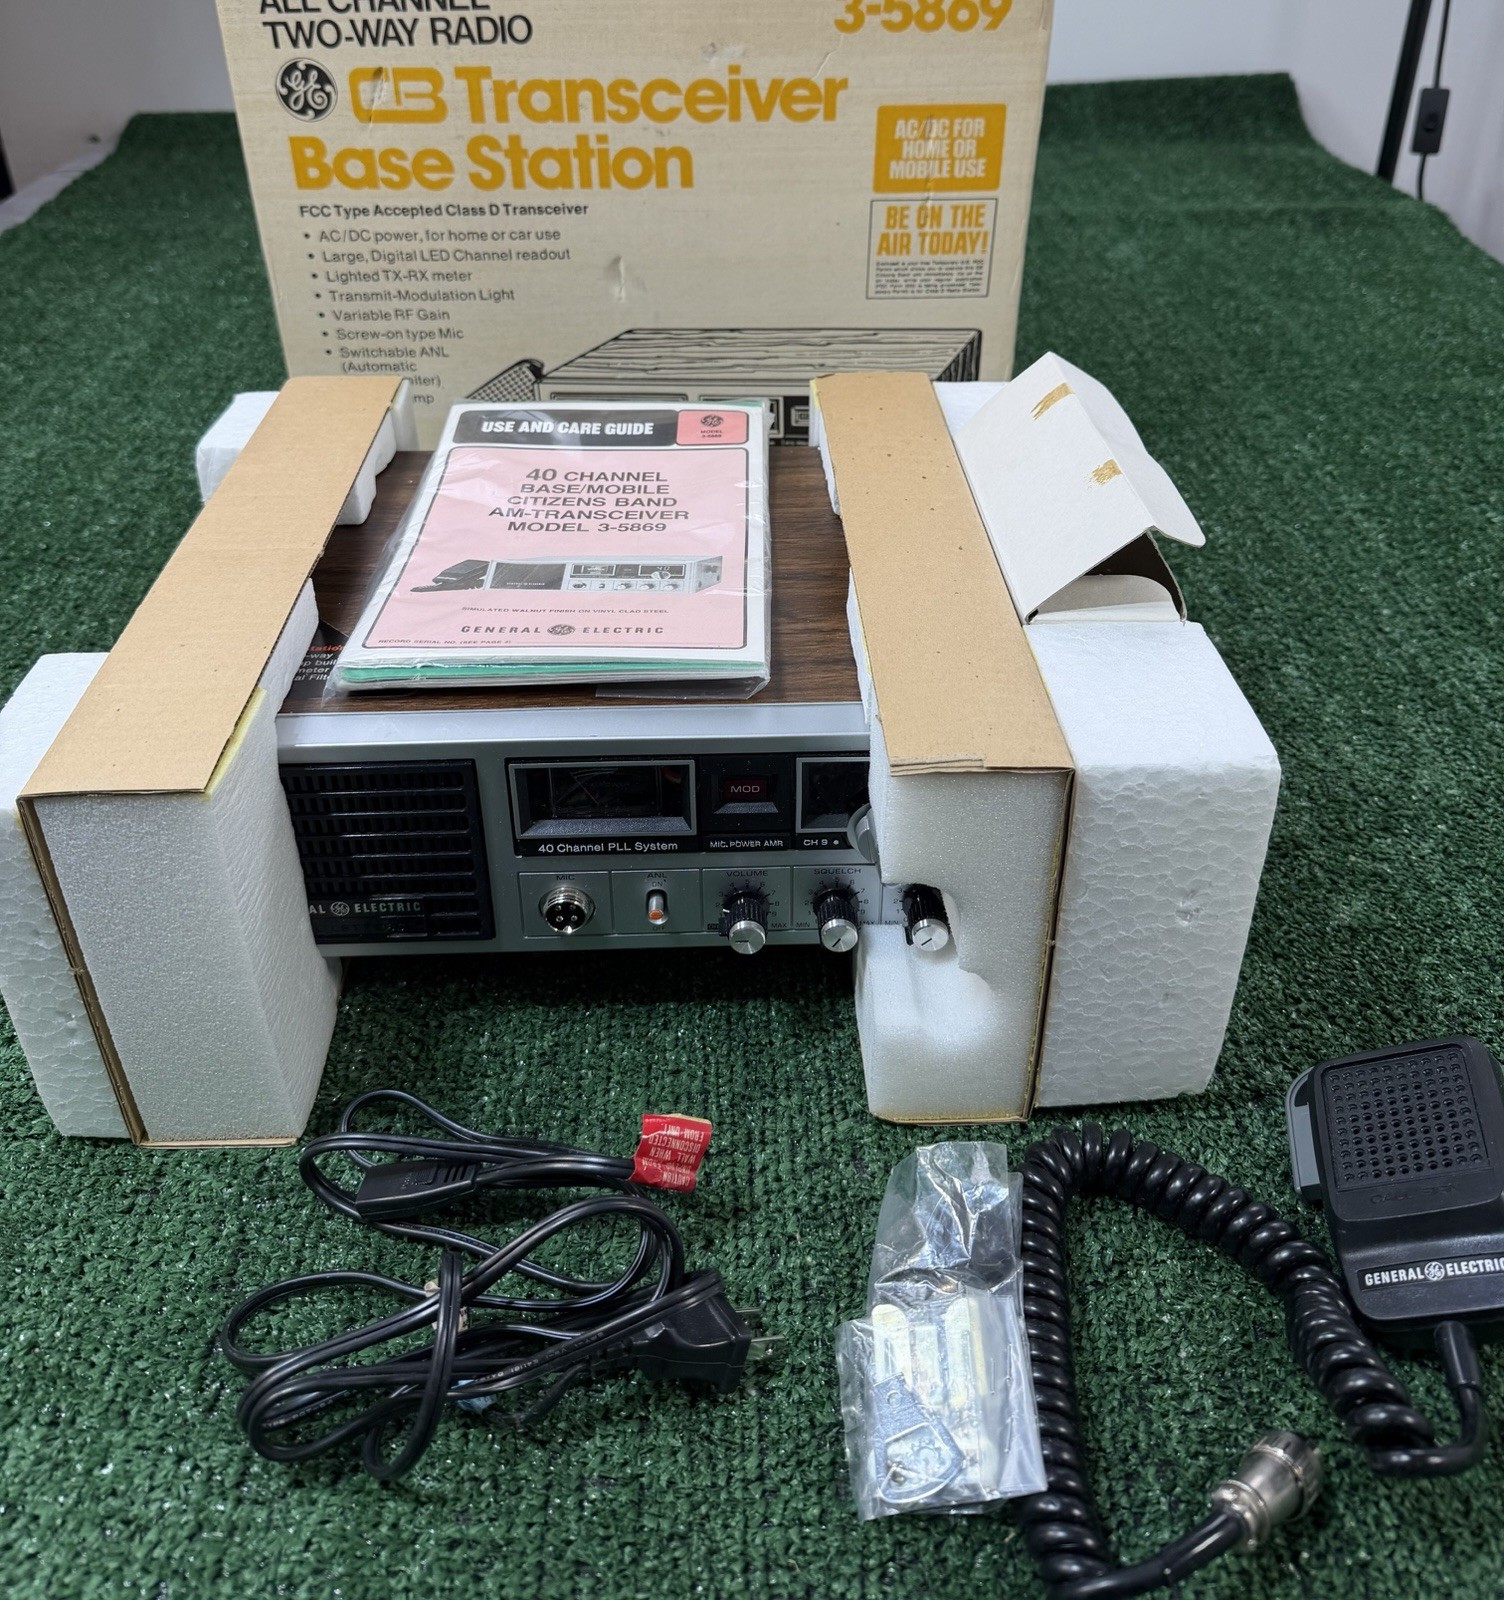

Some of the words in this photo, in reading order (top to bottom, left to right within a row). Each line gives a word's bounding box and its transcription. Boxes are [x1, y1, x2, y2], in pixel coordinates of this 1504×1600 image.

[833, 0, 1013, 34] 3-5869
[262, 18, 419, 49] TWO-WAY
[430, 15, 533, 46] RADIO
[348, 66, 448, 124] CB
[454, 64, 849, 124] Transceiver
[894, 117, 950, 139] AC/DC
[952, 117, 985, 138] FOR
[902, 139, 951, 160] HOME
[952, 139, 977, 159] OR
[288, 135, 455, 191] Base
[466, 134, 694, 190] Station
[889, 159, 951, 179] MOBILE
[953, 158, 986, 178] USE
[299, 205, 332, 218] FCC
[333, 205, 371, 220] Type
[374, 204, 443, 219] Accepted
[446, 204, 487, 217] Class
[490, 205, 500, 217] D
[503, 203, 589, 217] Transceiver
[885, 205, 909, 229] BE
[916, 204, 943, 229] ON
[951, 203, 986, 229] THE
[319, 230, 372, 243] AC/DC
[374, 231, 424, 245] power,
[425, 229, 447, 242] for
[449, 230, 489, 242] home
[492, 231, 507, 241] or
[509, 231, 533, 241] car
[536, 231, 561, 241] use
[876, 231, 911, 256] AIR
[918, 230, 989, 255] TODAY!
[323, 251, 369, 265] Large,
[371, 250, 419, 263] Digital
[421, 250, 450, 262] LED
[453, 249, 513, 261] Channel
[516, 248, 571, 261] readout
[326, 270, 380, 284] Lighted
[382, 270, 430, 282] TX-RX
[432, 271, 473, 282] meter
[329, 289, 477, 302] Transmit-Modulation
[480, 288, 515, 303] Light
[332, 309, 392, 322] Variable
[394, 310, 415, 321] RF
[417, 309, 450, 321] Gain
[336, 328, 404, 340] Screw-on
[406, 328, 437, 342] type
[439, 328, 464, 339] Mic
[339, 346, 417, 359] Switchable
[420, 347, 449, 359] ANL
[341, 361, 418, 374] (Automatic
[481, 421, 514, 433] USE
[520, 421, 554, 434] AND
[558, 421, 602, 434] CARE
[604, 422, 655, 435] GUIDE
[525, 468, 557, 481] 40
[564, 471, 668, 482] CHANNEL
[519, 483, 670, 495] BASE/MOBILE
[507, 495, 607, 507] CITIZENS
[614, 496, 678, 507] BAND
[488, 507, 690, 521] AM-TRANSCEIVER
[507, 521, 589, 532] MODEL
[597, 522, 667, 532] 3-5869
[461, 625, 541, 634] GENERAL
[730, 785, 760, 793] MOD
[538, 844, 554, 853] 40
[556, 843, 604, 852] Channel
[608, 842, 631, 851] PLL
[634, 841, 678, 852] System
[730, 840, 761, 848] POWER
[354, 902, 422, 913] ELECTRIC
[648, 1134, 701, 1152] DISCONNECTED
[649, 1147, 672, 1161] WHEN
[1365, 1266, 1424, 1286] GENERAL
